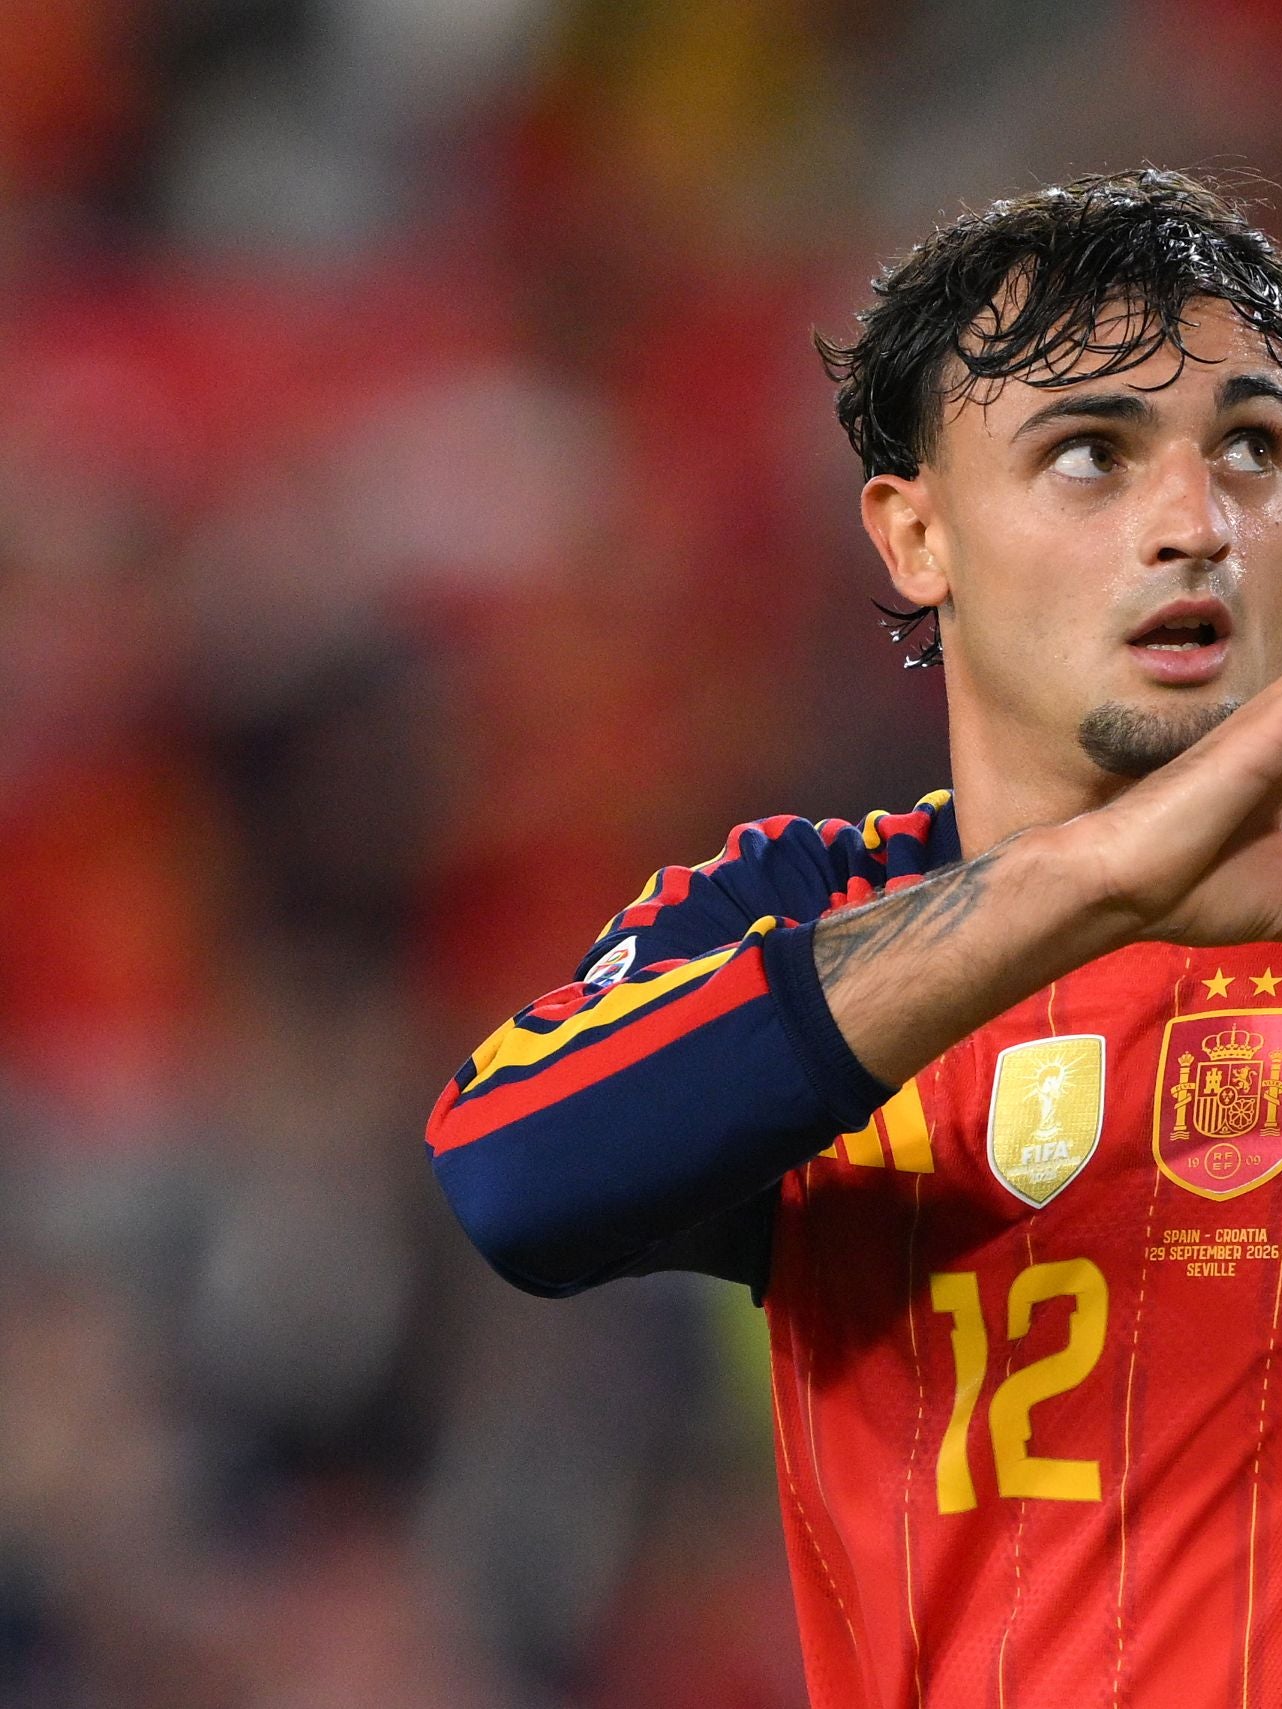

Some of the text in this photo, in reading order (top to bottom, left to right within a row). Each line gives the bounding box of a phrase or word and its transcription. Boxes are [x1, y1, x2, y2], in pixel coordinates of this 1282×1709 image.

[1022, 1140, 1069, 1165] FIFA
[1163, 1229, 1200, 1243] SPAIN
[1215, 1228, 1268, 1243] CROATIA
[1149, 1245, 1280, 1261] 29 SEPTEMBER 2026
[1186, 1262, 1237, 1277] SEVILLE
[930, 1257, 1109, 1516] 12
